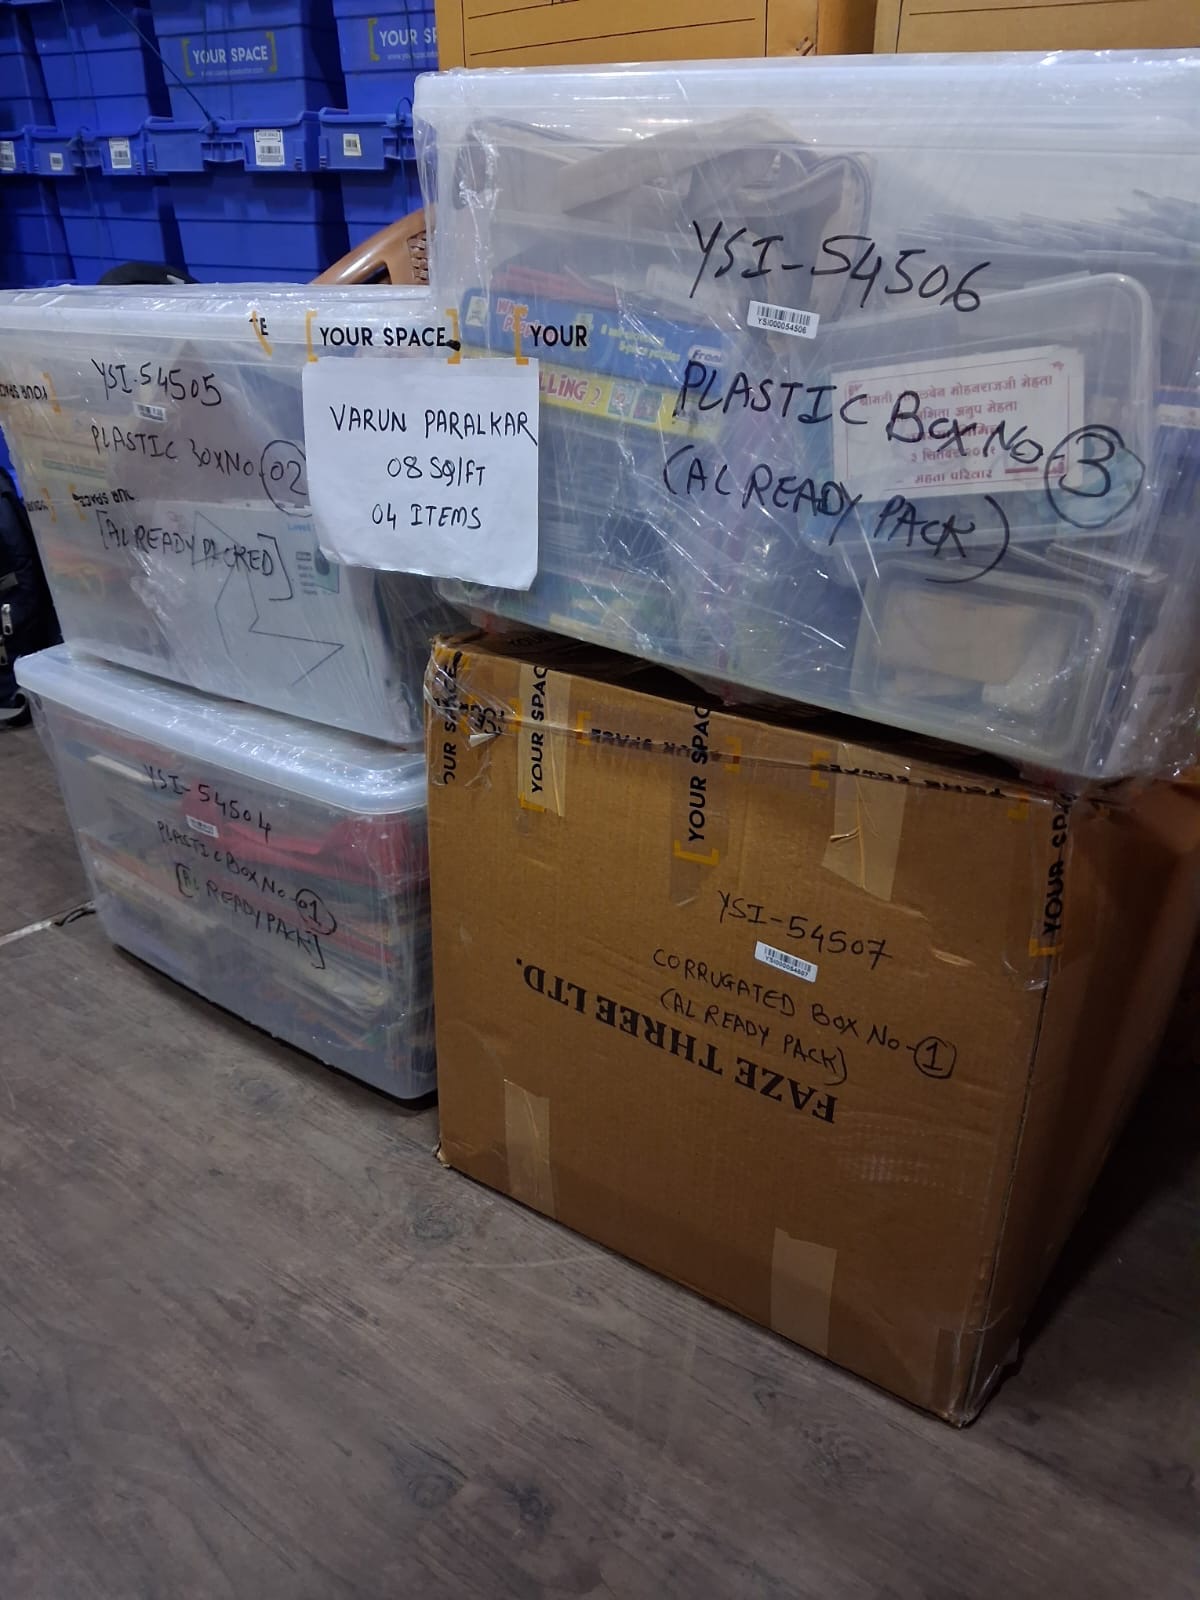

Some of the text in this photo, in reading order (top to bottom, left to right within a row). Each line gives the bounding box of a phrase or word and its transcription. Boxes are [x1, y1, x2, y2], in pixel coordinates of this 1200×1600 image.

[193, 46, 268, 64] YOUR SPACE
[379, 29, 417, 47] YOUR
[320, 327, 446, 347] YOUR SPACE
[530, 325, 587, 347] YOUR
[672, 359, 868, 426] PLASTIC
[91, 424, 179, 460] PLASTIC
[329, 404, 538, 446] VARUN PARALKAR
[386, 455, 423, 478] 08
[371, 504, 482, 530] 04 ITEMS
[531, 733, 544, 794] YOUR
[688, 776, 707, 843] YOUR
[157, 820, 221, 862] PLASTIC
[1043, 859, 1065, 936] YOUR
[718, 890, 893, 970] YSI-54507
[653, 947, 796, 1017] CORRUGATED
[515, 956, 838, 1124] FAZE THREE LTD.
